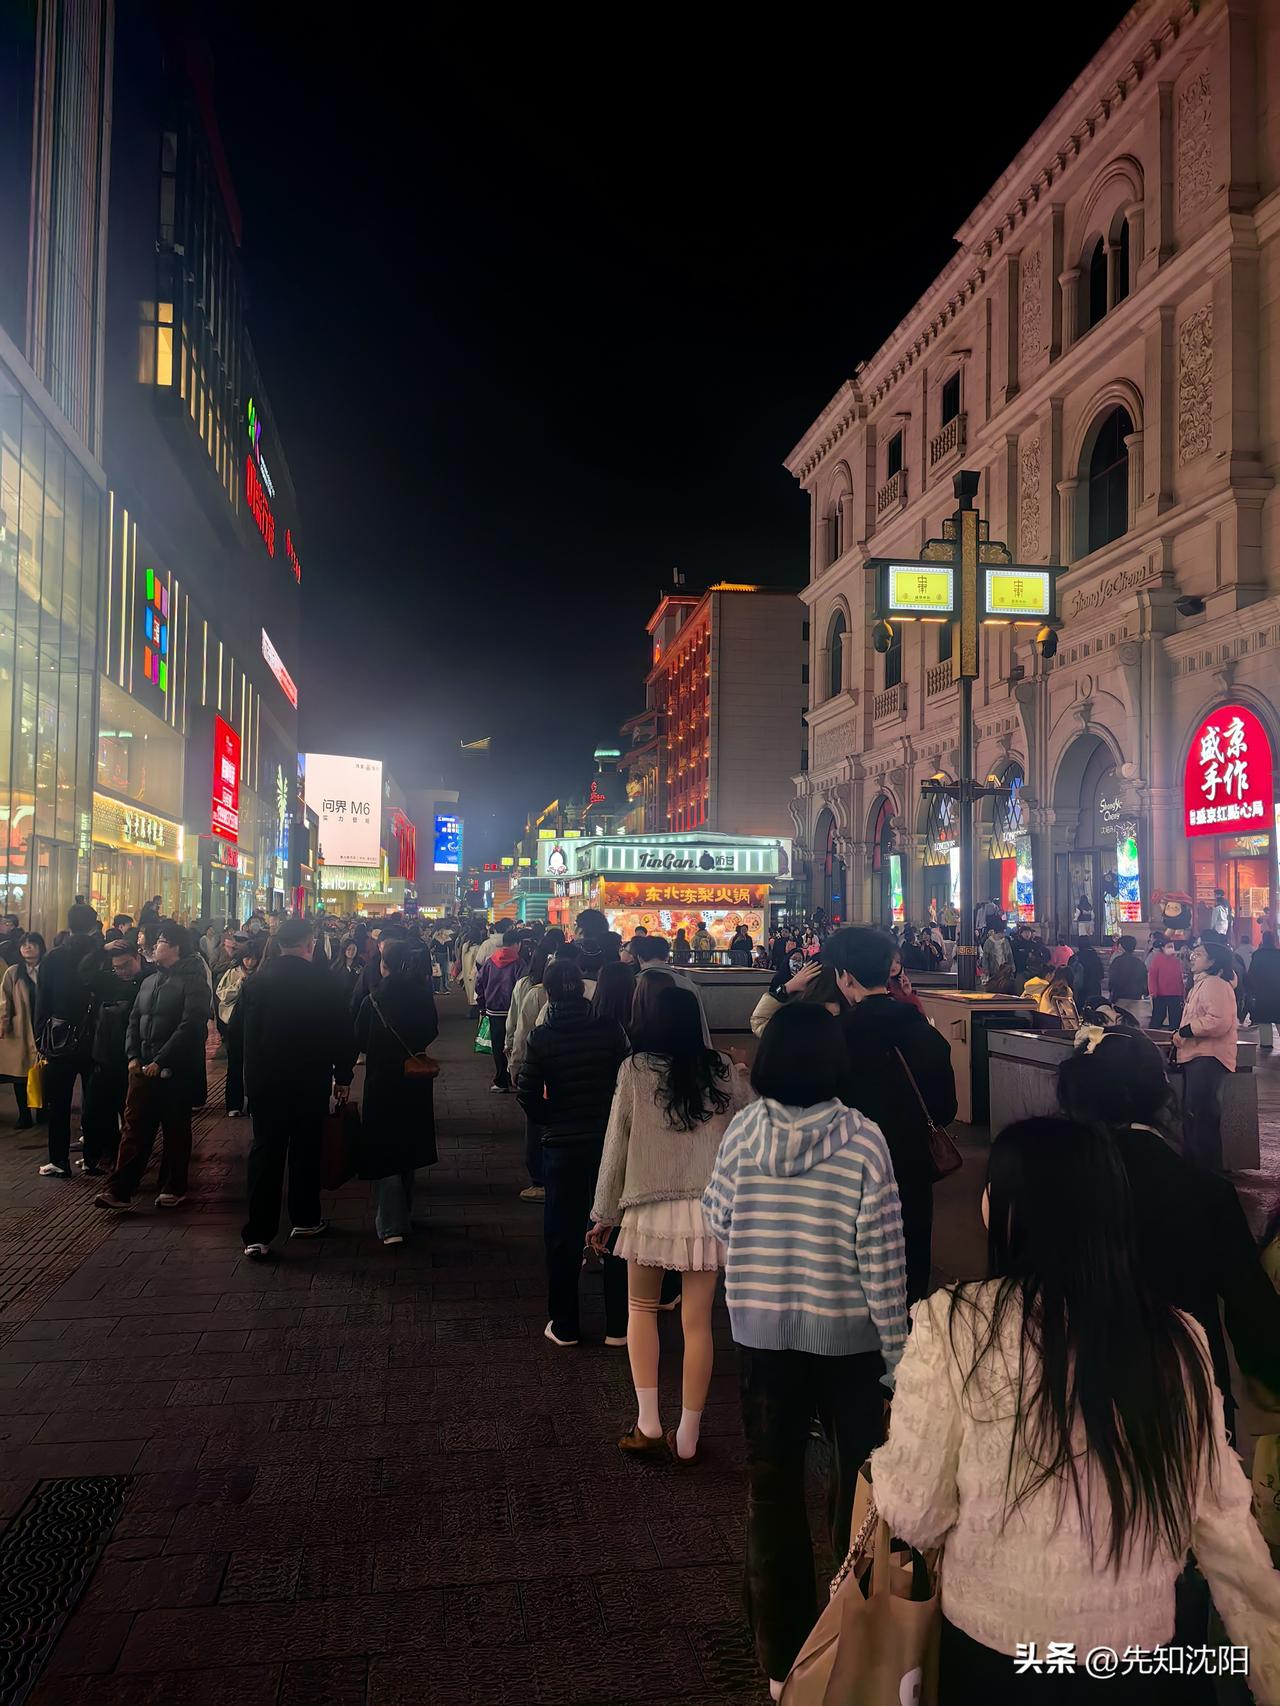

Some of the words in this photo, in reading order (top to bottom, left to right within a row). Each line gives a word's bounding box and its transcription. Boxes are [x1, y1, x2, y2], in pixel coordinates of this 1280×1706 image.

[1200, 716, 1248, 766] 盛京
[1201, 759, 1249, 801] 手作
[322, 799, 347, 813] 问界
[351, 801, 370, 815] M6
[645, 886, 751, 905] 东北冻梨火锅
